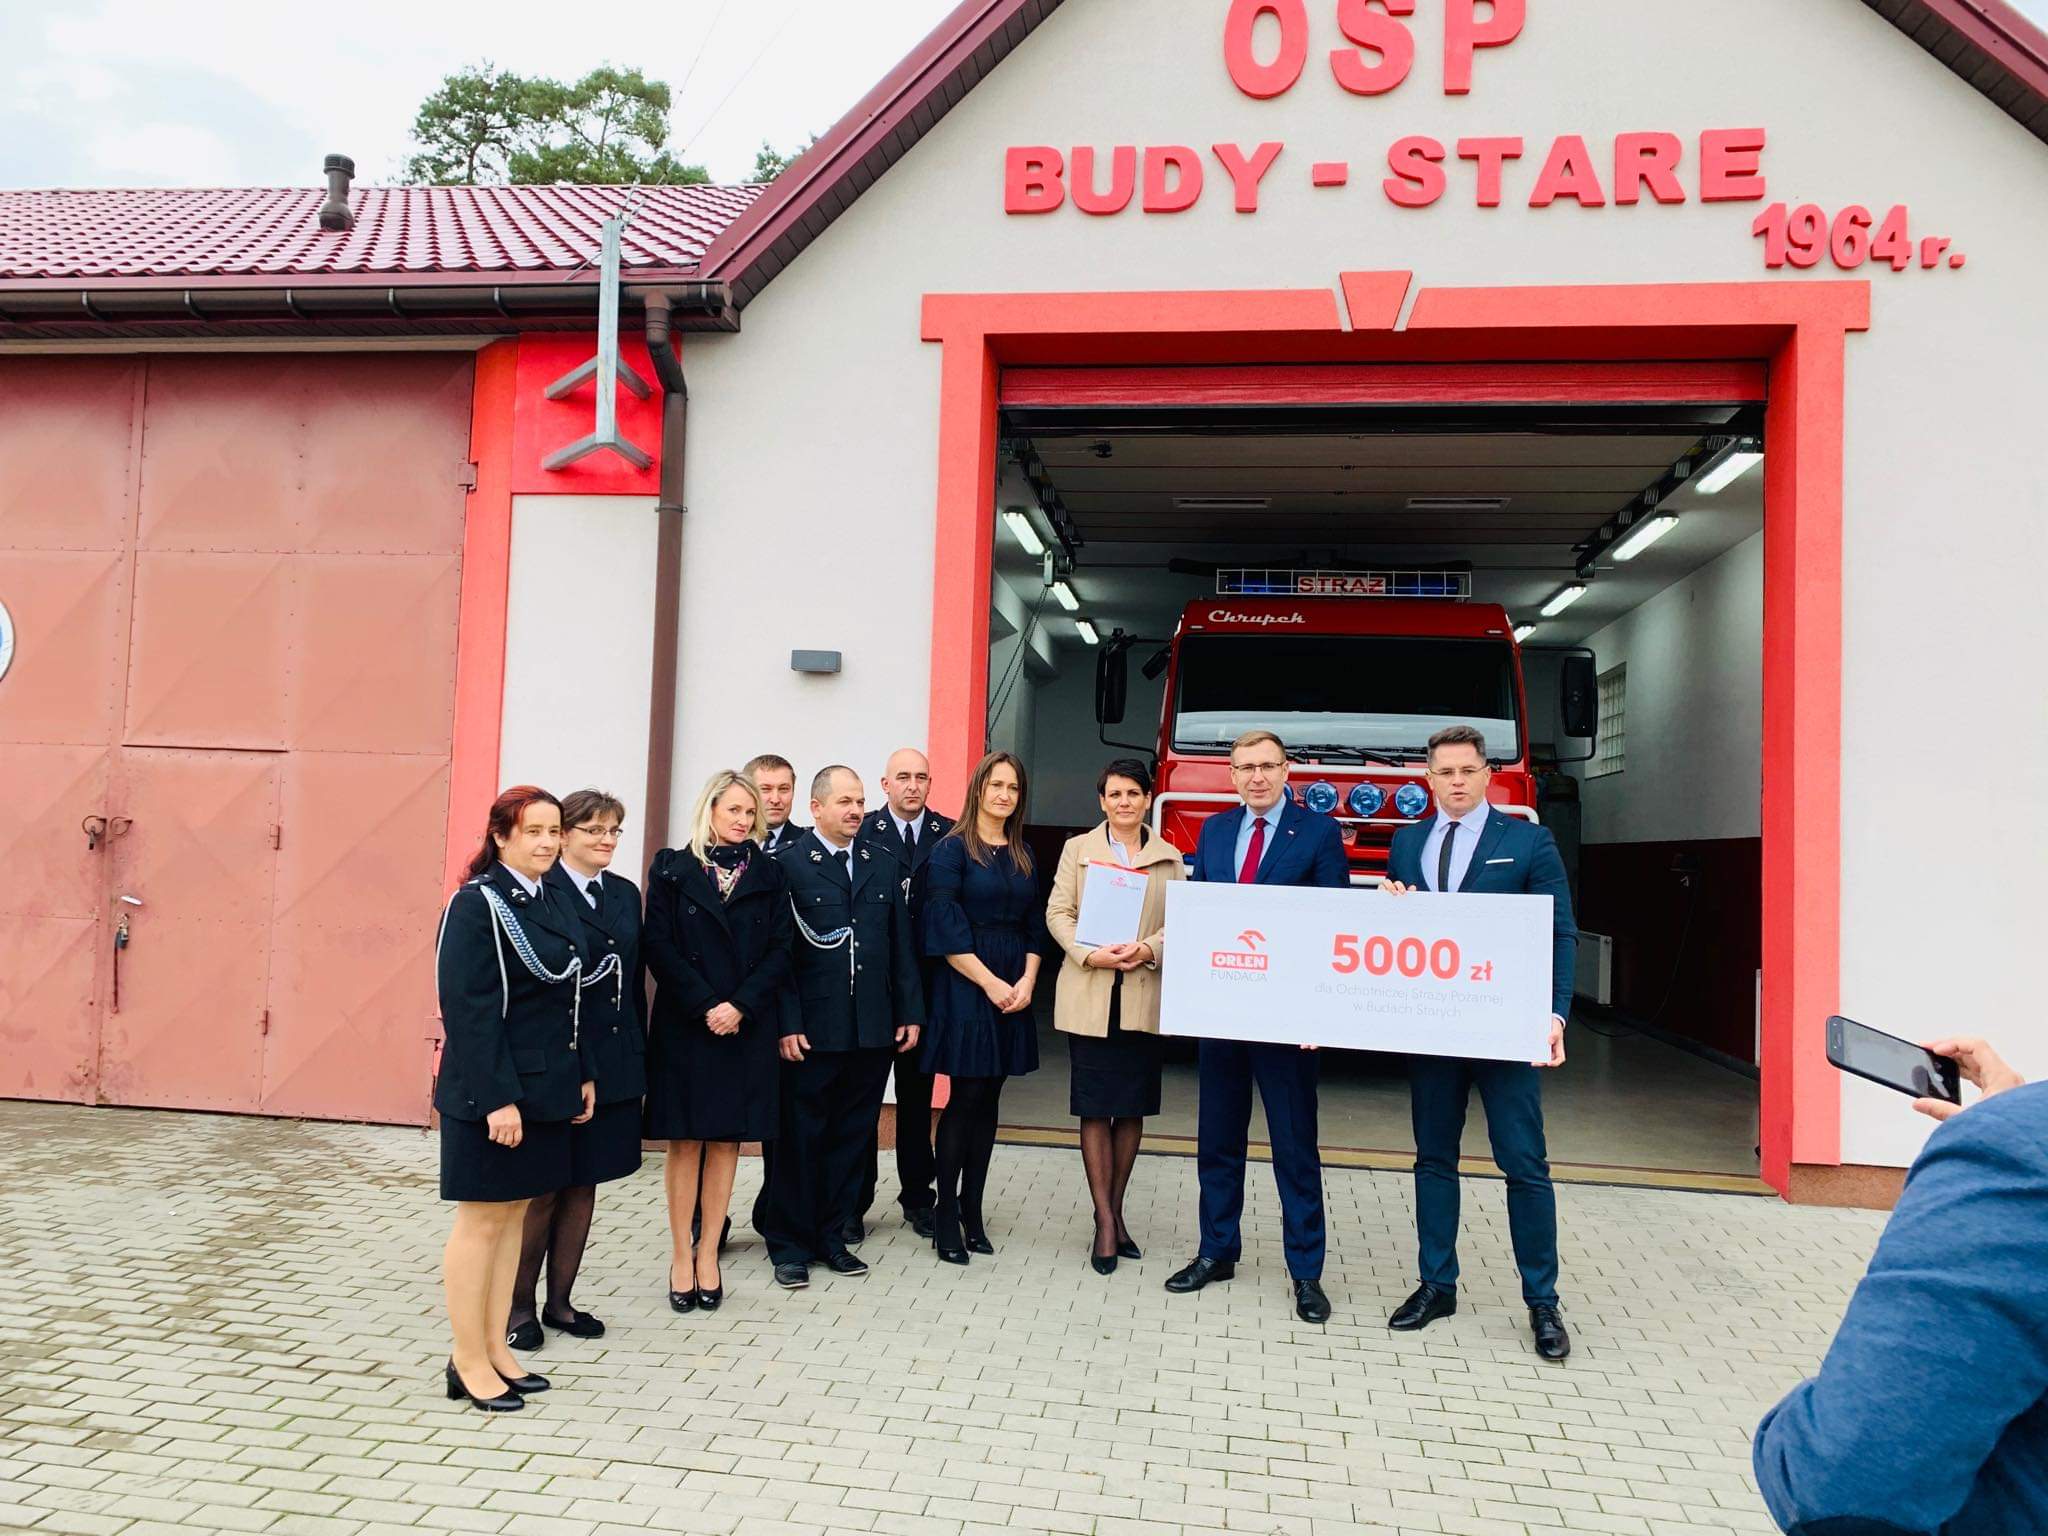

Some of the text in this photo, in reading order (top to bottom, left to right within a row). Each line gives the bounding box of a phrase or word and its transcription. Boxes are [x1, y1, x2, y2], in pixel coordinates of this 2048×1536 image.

[1224, 0, 1526, 99] OSP
[1005, 142, 1283, 214] BUDY
[1383, 128, 1767, 207] STARE
[1214, 953, 1265, 968] ORLEN
[1331, 934, 1494, 982] 5000 zł
[1211, 969, 1268, 983] FUNDACJA
[1314, 982, 1332, 994] dla
[1336, 983, 1408, 1001] Ochotniczej
[1352, 1000, 1462, 1020] w Budach Starych
